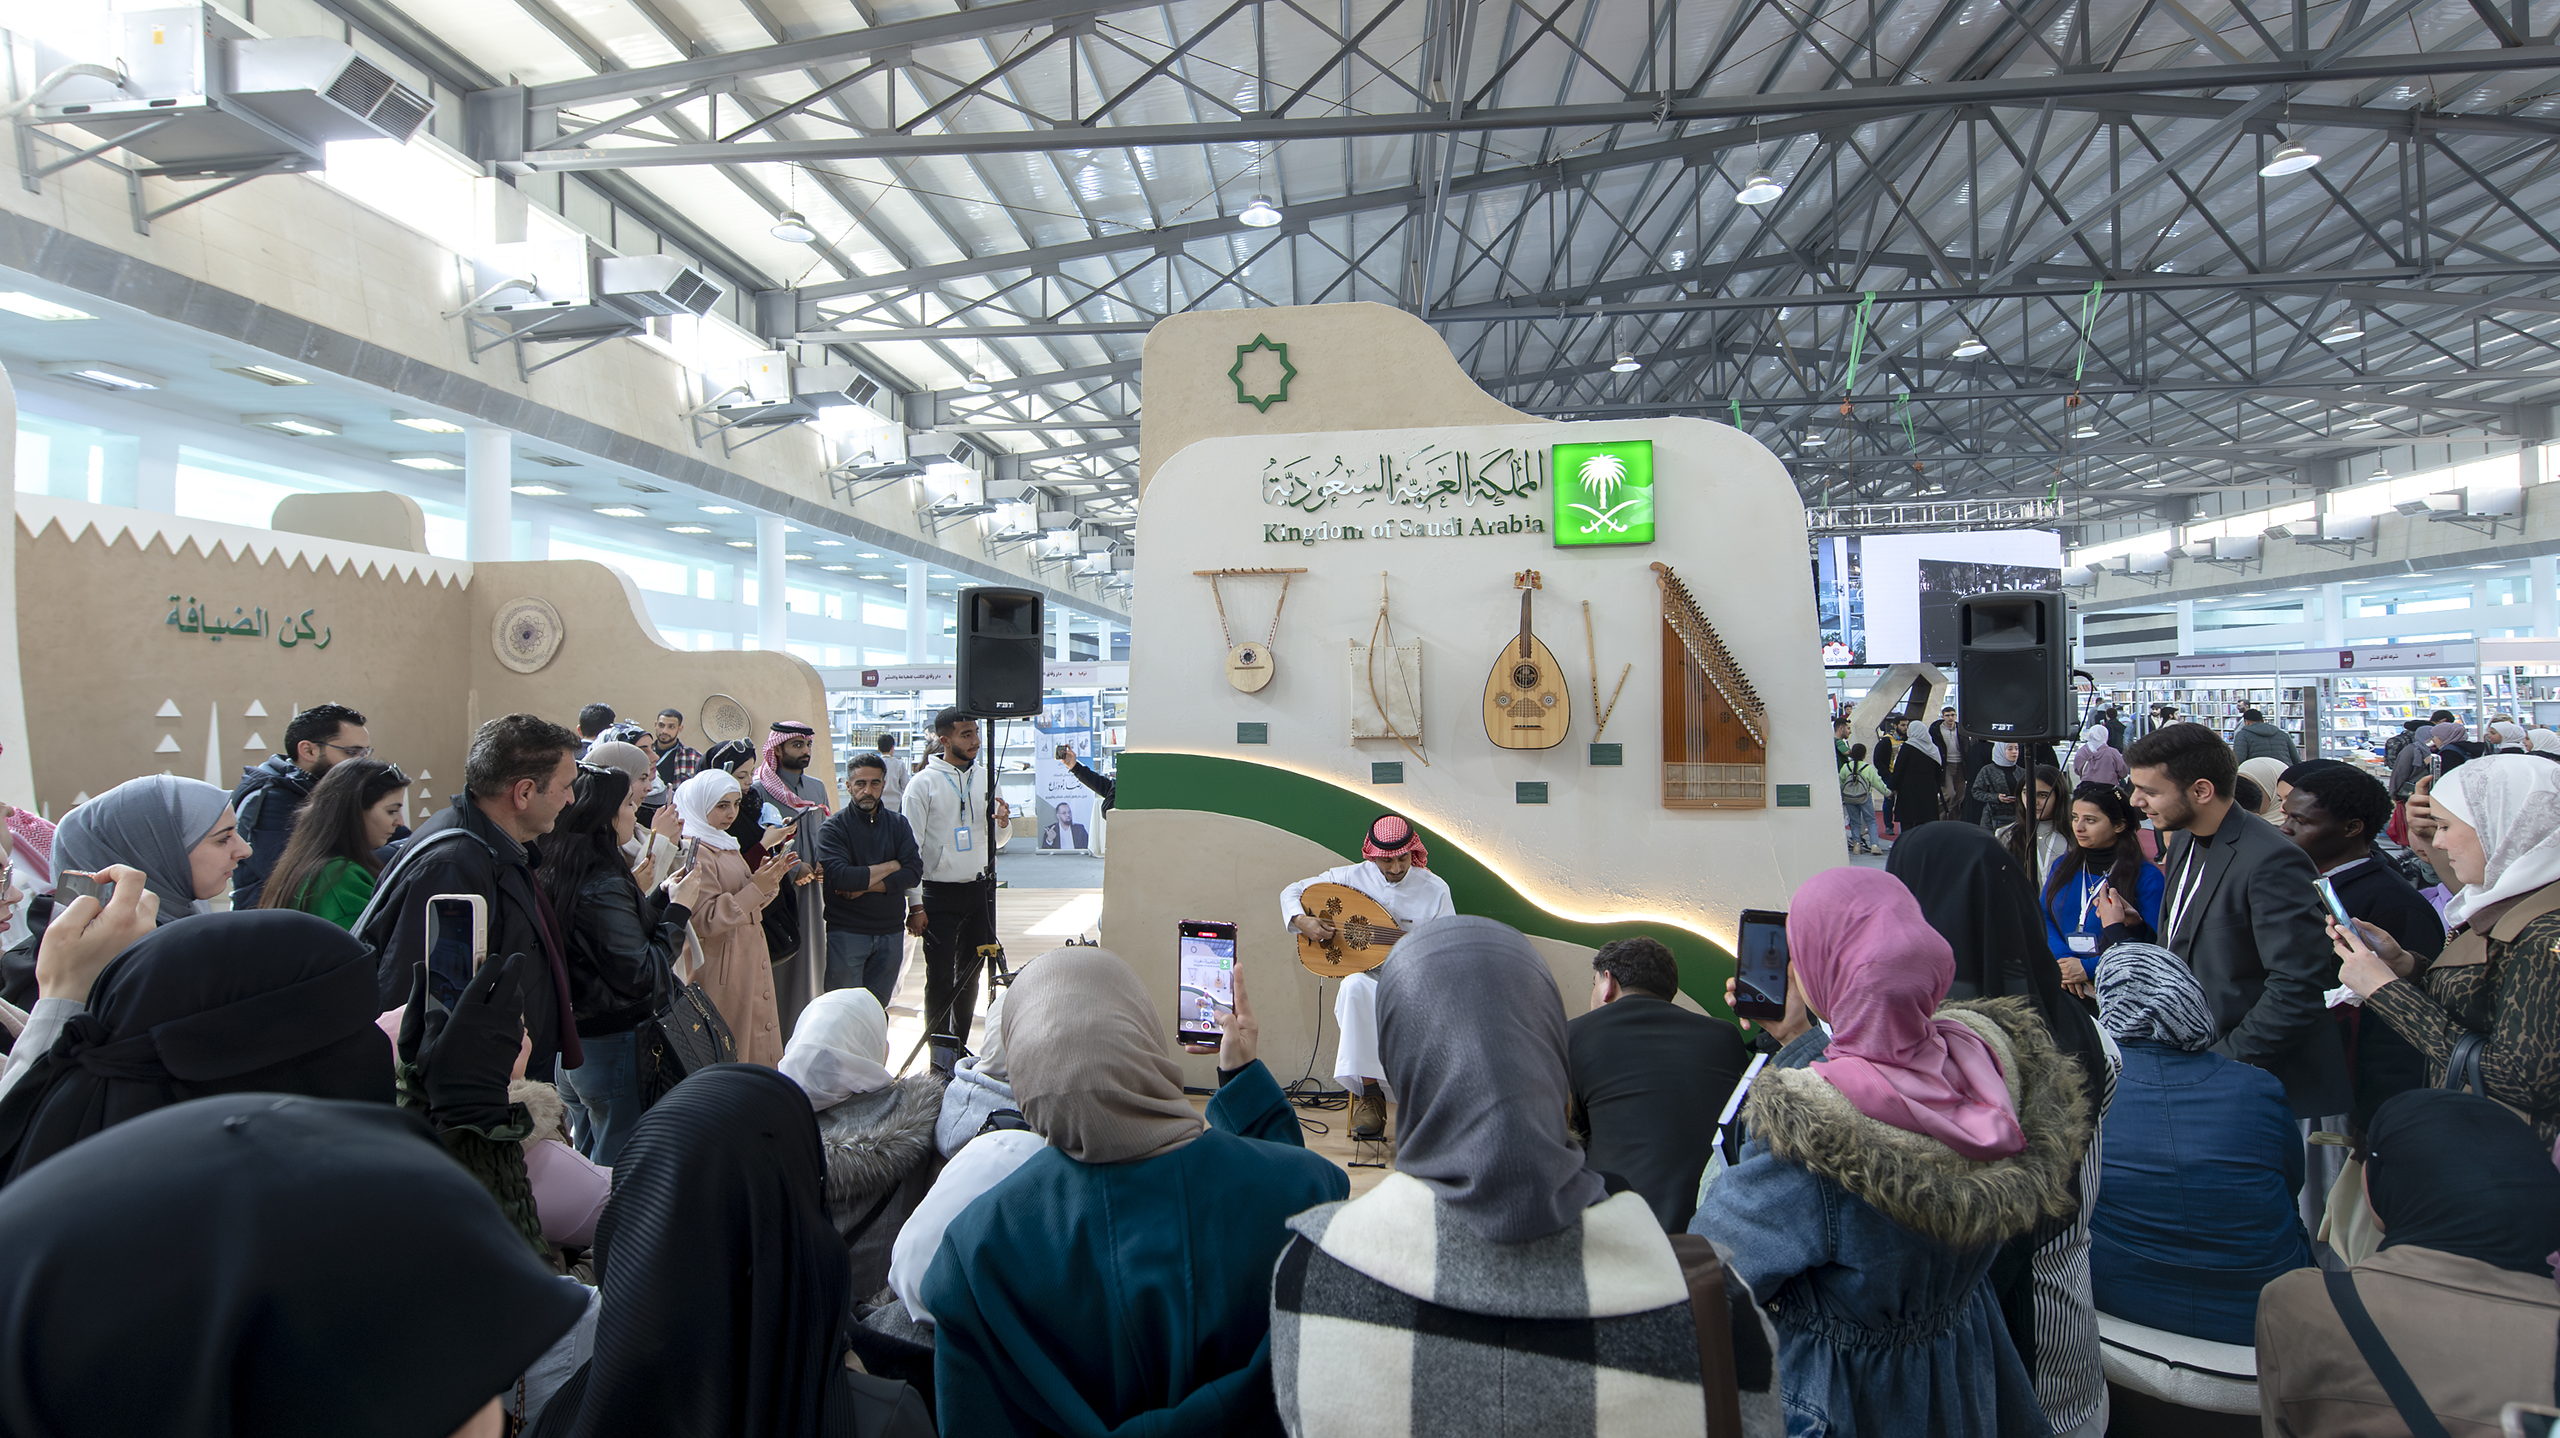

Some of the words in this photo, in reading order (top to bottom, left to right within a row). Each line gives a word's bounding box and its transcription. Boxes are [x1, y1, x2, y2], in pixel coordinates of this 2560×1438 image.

[1263, 522, 1364, 546] Kingdom
[1370, 518, 1395, 538] of
[1399, 516, 1464, 538] Saudi
[1468, 514, 1545, 536] Arabia
[165, 595, 269, 642] الضيافة
[278, 608, 331, 649] ركن
[1991, 723, 2014, 731] FBT
